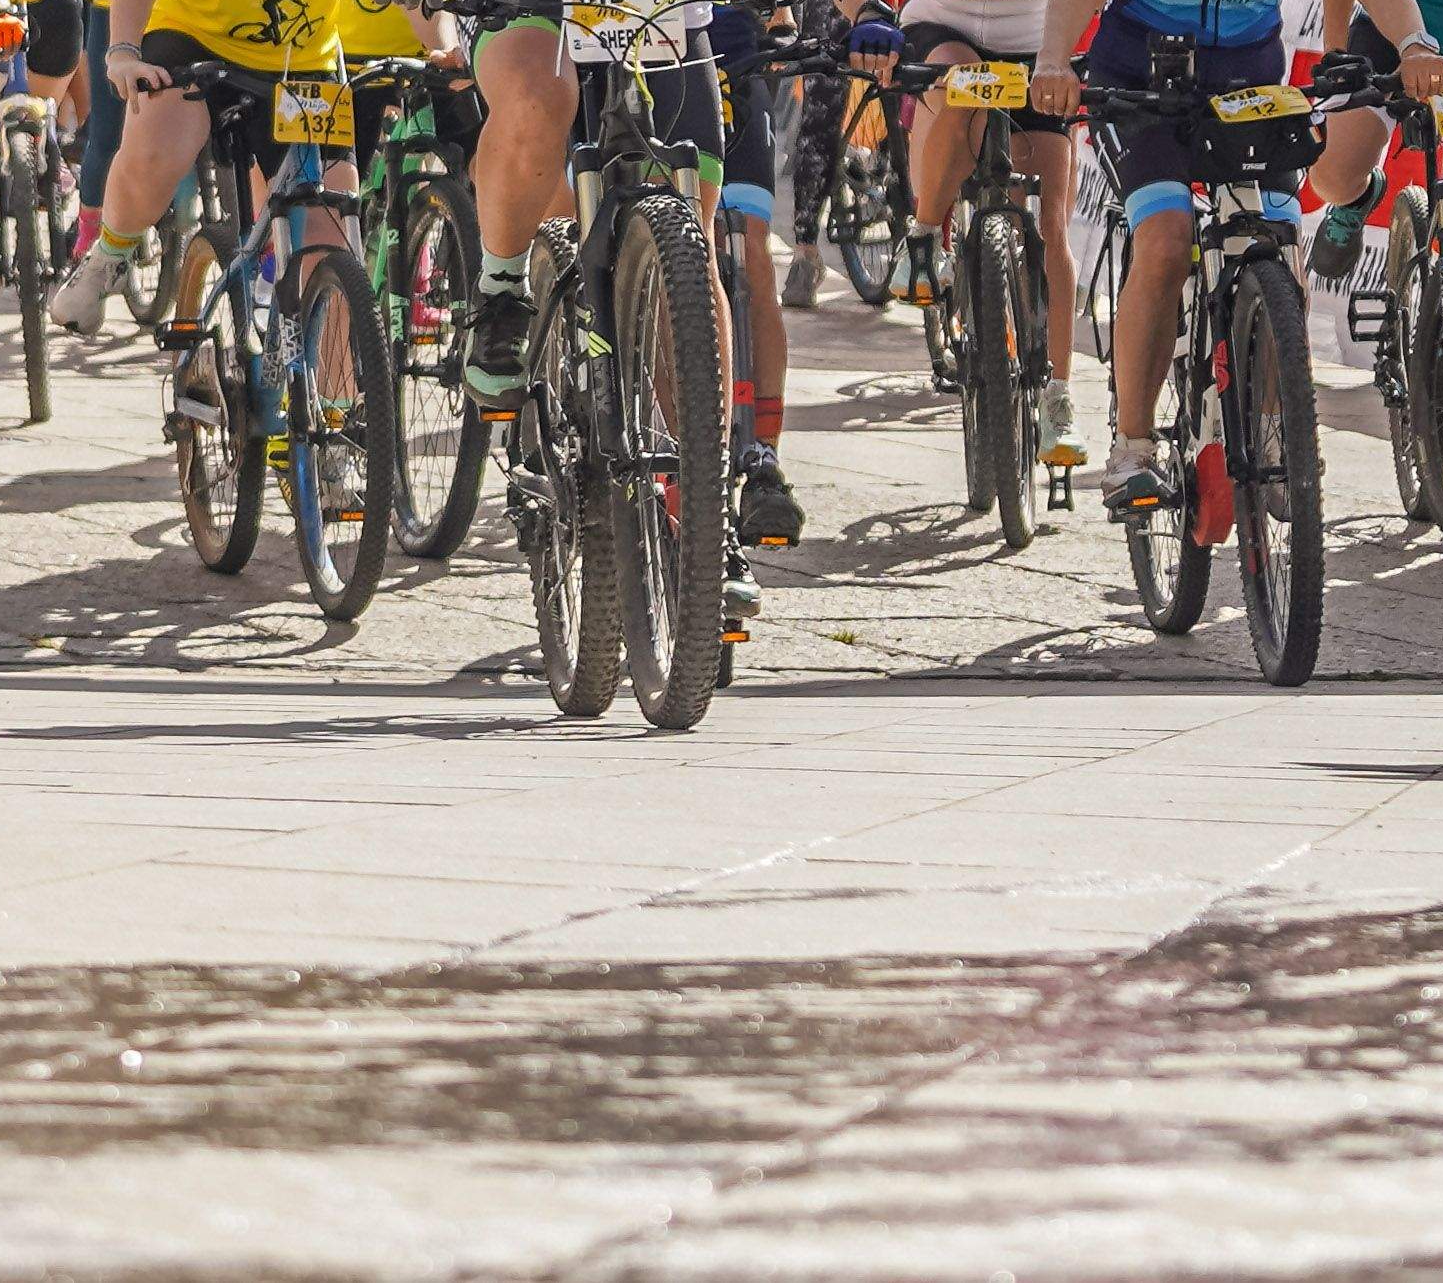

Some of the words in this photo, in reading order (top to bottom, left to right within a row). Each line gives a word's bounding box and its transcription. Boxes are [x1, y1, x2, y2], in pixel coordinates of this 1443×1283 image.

[599, 27, 653, 50] SHERA
[970, 84, 1005, 100] 187
[1250, 103, 1279, 117] 12
[299, 115, 336, 134] 132
